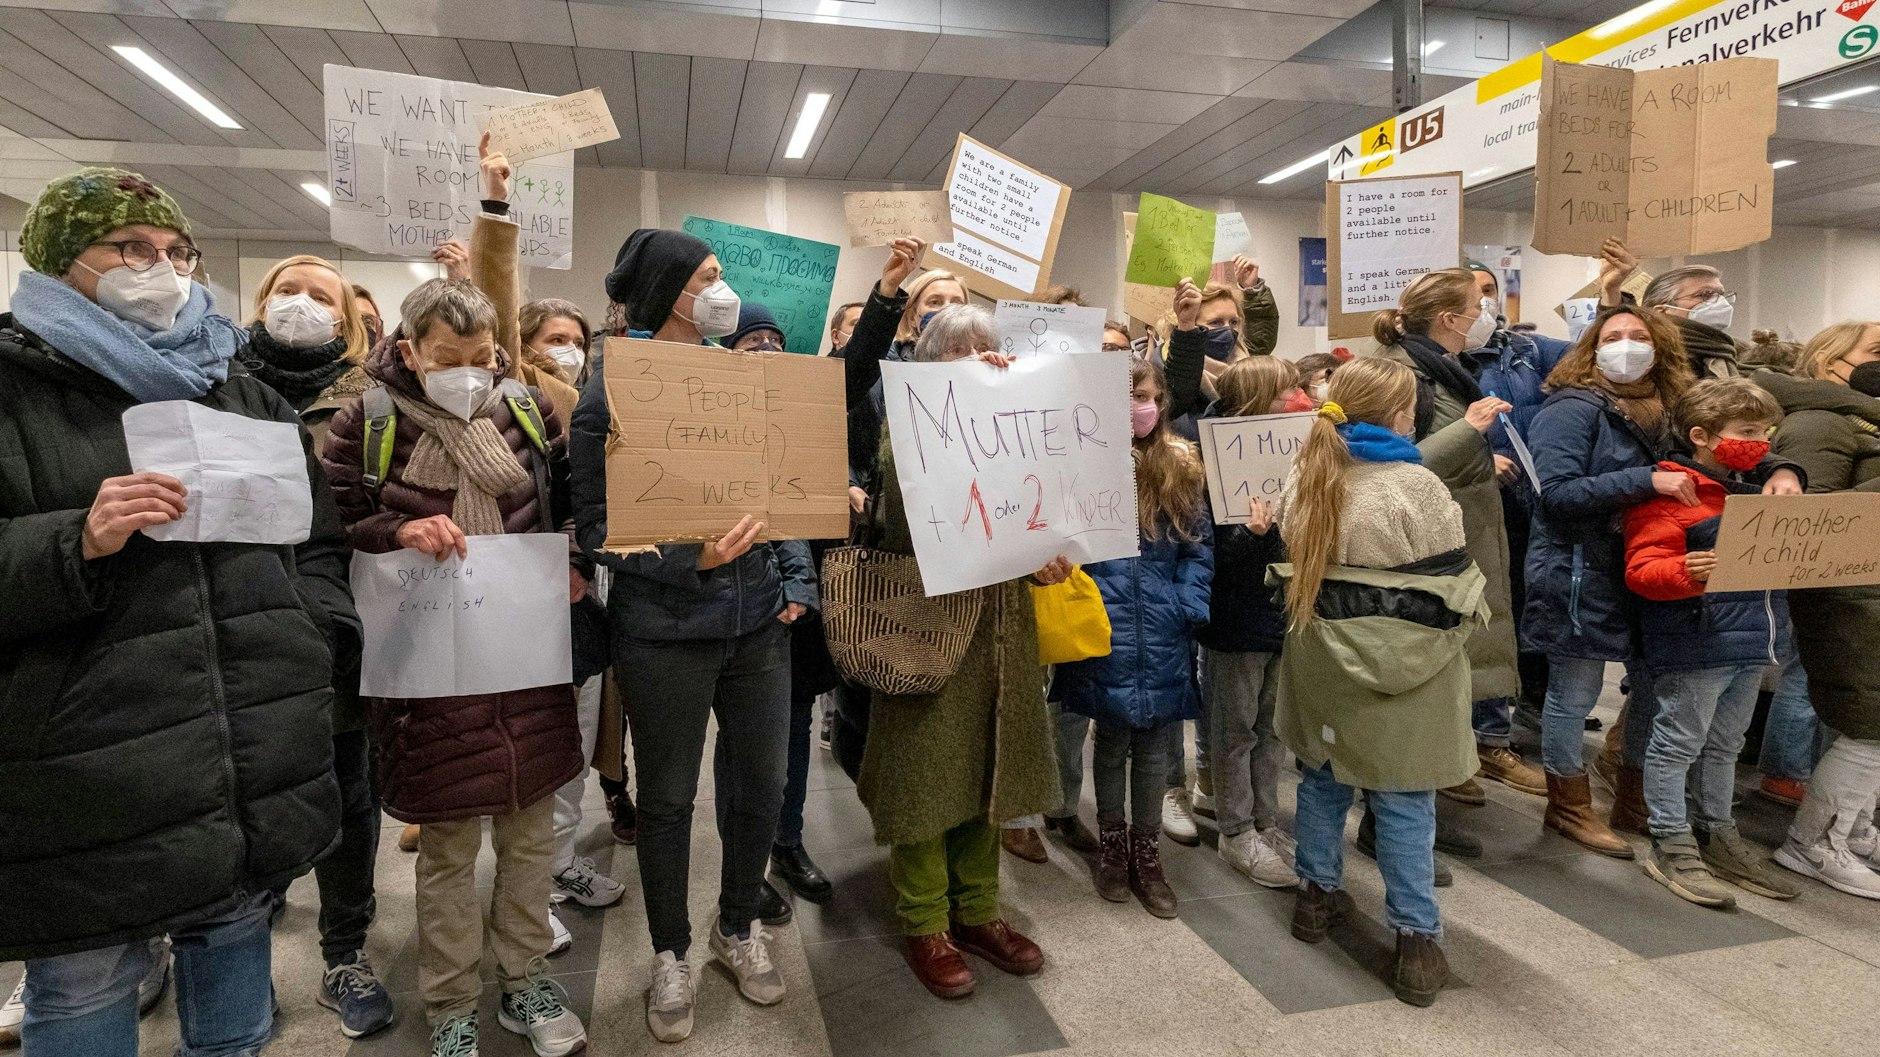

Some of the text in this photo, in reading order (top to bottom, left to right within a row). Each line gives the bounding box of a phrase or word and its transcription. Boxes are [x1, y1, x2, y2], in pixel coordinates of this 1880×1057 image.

[344, 88, 468, 124] WE WANT
[1500, 86, 1541, 115] main-l
[1558, 79, 1732, 112] WE HAVE A ROOM
[499, 108, 538, 124] MOTHER
[551, 98, 587, 112] CHILD
[577, 125, 608, 140] weeks
[1405, 111, 1440, 147] U5
[1483, 120, 1538, 148] local tra
[1558, 112, 1646, 139] BEDS FOR
[333, 125, 352, 172] WEEKS
[380, 131, 479, 165] WE HAVE
[505, 138, 555, 158] 2 Month
[964, 150, 975, 161] We
[979, 159, 995, 171] are
[1009, 172, 1040, 192] family
[1561, 151, 1659, 174] 2 ADULTS
[416, 165, 480, 193] ROOM
[958, 172, 999, 197] children
[1003, 193, 1024, 208] have
[962, 161, 1031, 200] with two small
[1598, 179, 1613, 192] OR
[859, 200, 869, 209] 2
[956, 183, 1041, 227] room for 2 people
[1347, 188, 1449, 203] I have a room for
[1560, 198, 1573, 225] 1
[1578, 200, 1624, 223] ADULT
[1644, 184, 1758, 219] CHILDREN
[408, 200, 472, 225] BEDS
[950, 203, 1024, 243] further notice.
[952, 193, 1028, 233] available until
[1148, 206, 1158, 230] 1
[1159, 210, 1180, 232] Bed
[1346, 204, 1396, 216] 2 people
[1346, 213, 1437, 228] available until
[1154, 238, 1171, 252] 2
[1347, 227, 1436, 240] further notice.
[938, 244, 995, 275] and English
[956, 241, 1018, 273] speak German
[1347, 266, 1431, 281] I speak German
[1347, 280, 1408, 293] and a litt
[1347, 295, 1394, 306] English.
[1569, 305, 1583, 319] 2
[630, 358, 783, 421] 3 PEOPLE
[905, 380, 1108, 474] MUTTER
[1226, 434, 1242, 461] 1
[635, 460, 808, 505] 2 WEEKS
[1234, 480, 1250, 497] 1
[961, 477, 993, 548] 1
[1023, 474, 1048, 532] 2
[1058, 470, 1127, 527] KINDER
[1741, 507, 1861, 538] 1 mother
[1738, 538, 1823, 565] 1 child
[398, 567, 473, 589] DEUTSCH
[1789, 559, 1878, 585] for 2 weeks
